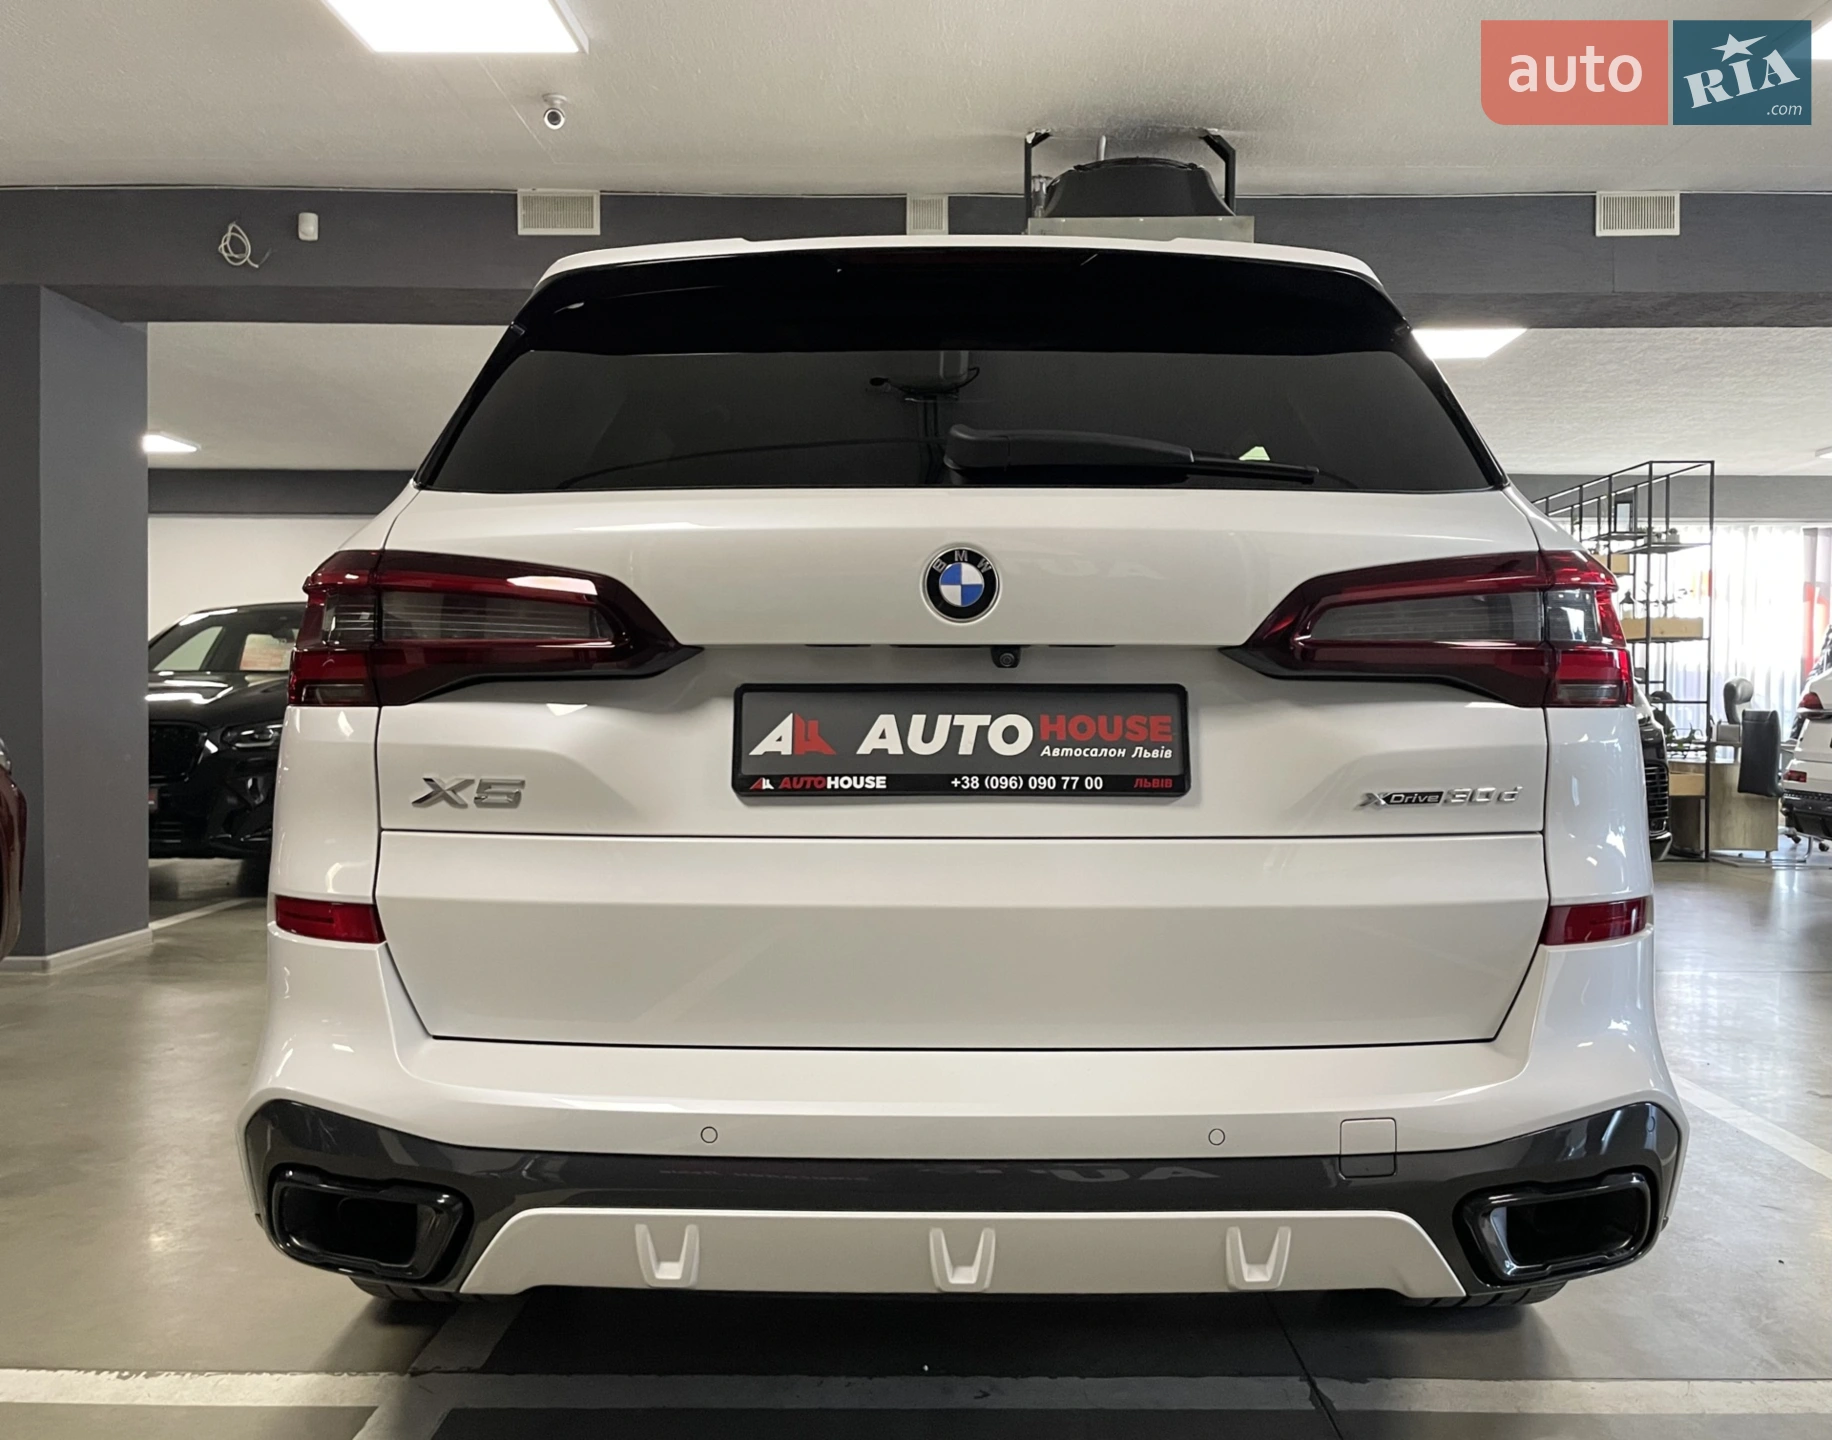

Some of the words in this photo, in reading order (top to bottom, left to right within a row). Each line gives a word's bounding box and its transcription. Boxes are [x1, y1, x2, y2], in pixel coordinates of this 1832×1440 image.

[932, 550, 992, 573] BMW
[856, 714, 1034, 756] AUTO
[1039, 714, 1173, 742] HOUSE
[1040, 745, 1126, 758] Автосалон
[1131, 746, 1173, 759] Львів
[779, 776, 887, 789] AUTOHOUSE
[951, 776, 980, 789] +38
[984, 776, 1024, 790] (096)
[1028, 776, 1057, 790] 090
[1061, 777, 1079, 790] 77
[1084, 777, 1104, 790] 00
[1133, 778, 1173, 789] ЛЬВІВ
[411, 777, 526, 809] X5
